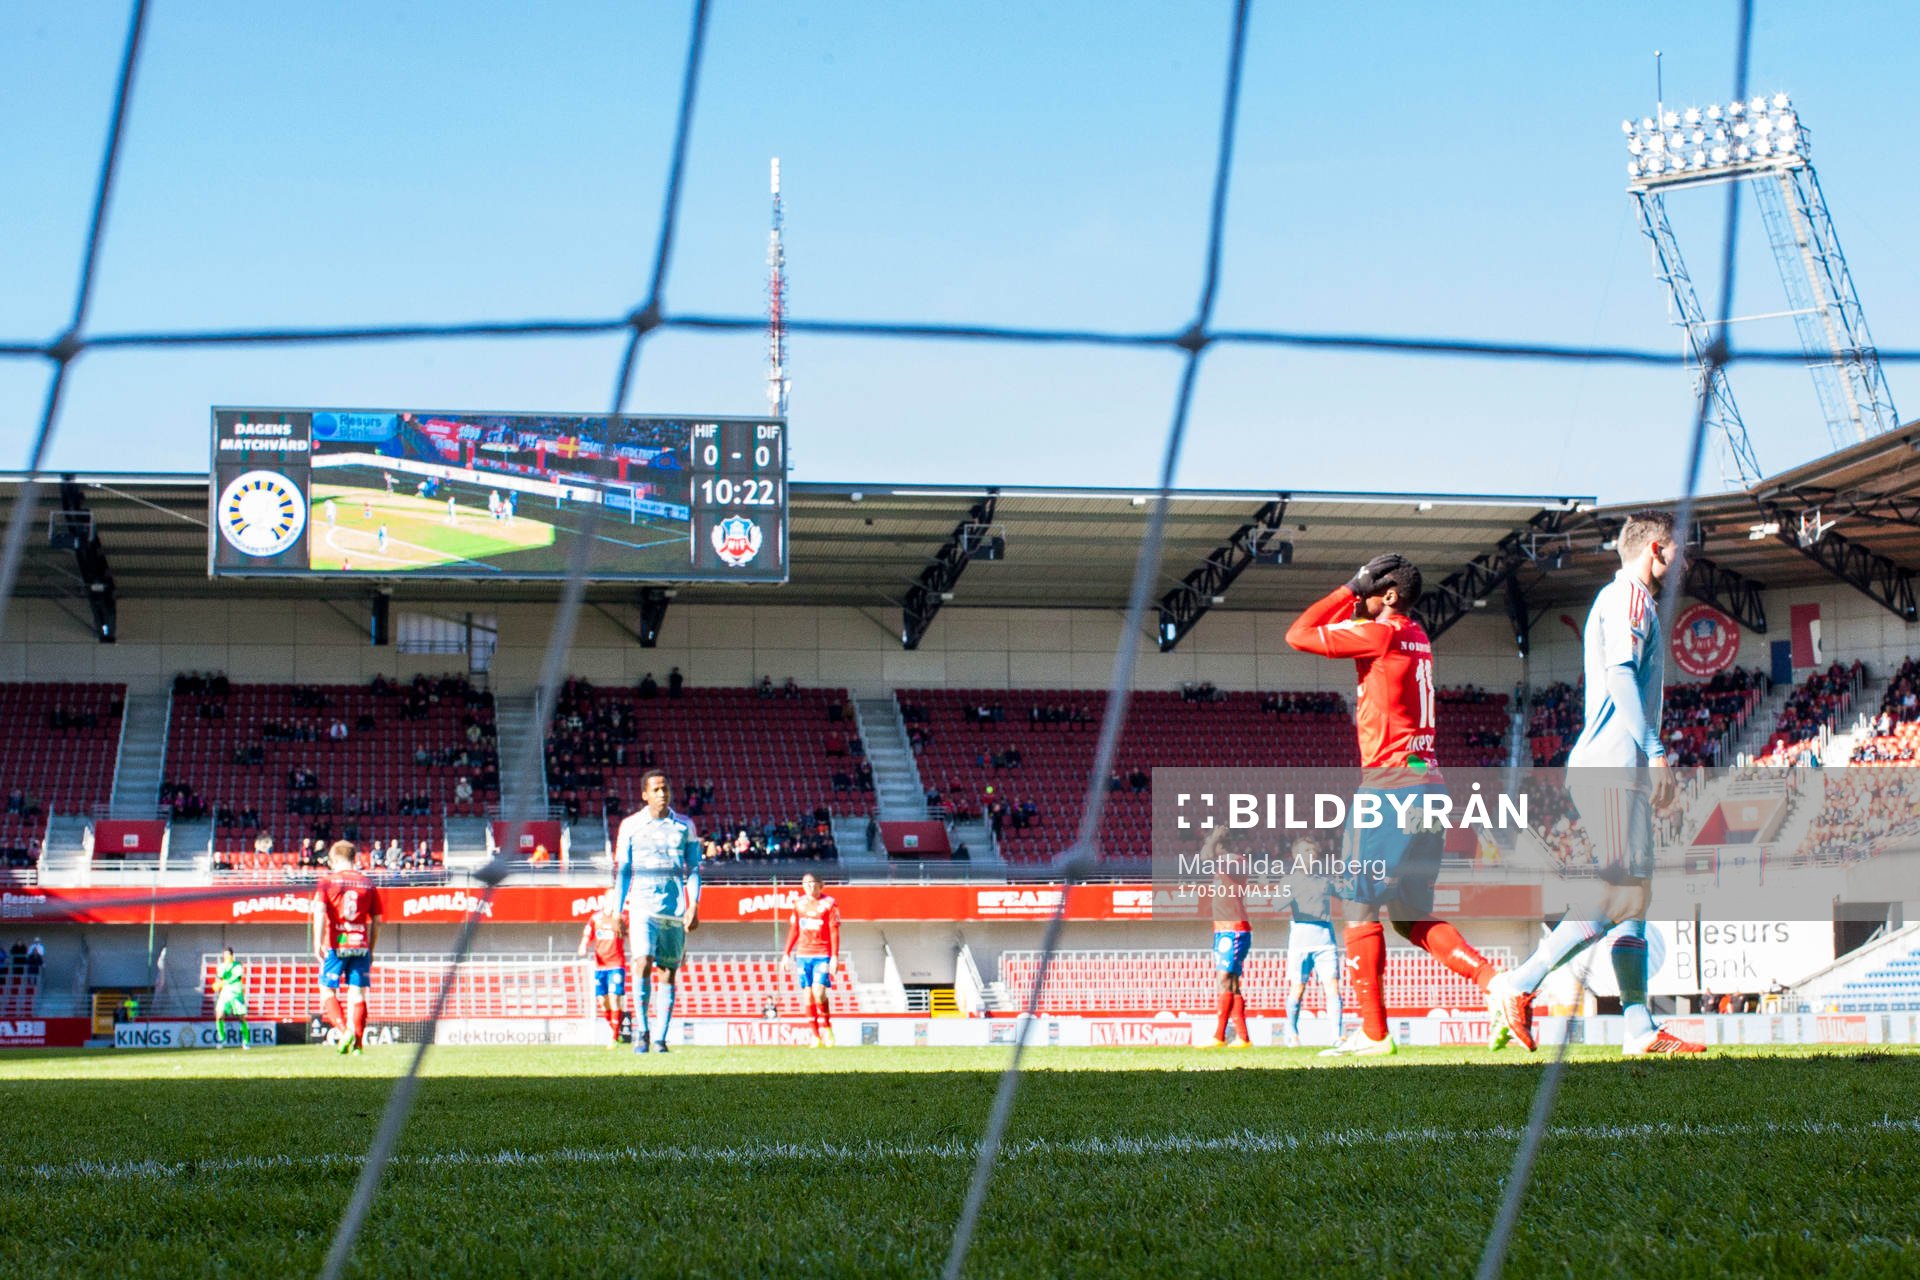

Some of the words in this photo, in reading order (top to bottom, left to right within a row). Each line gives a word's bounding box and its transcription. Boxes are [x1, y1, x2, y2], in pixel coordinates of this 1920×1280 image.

[234, 423, 292, 436] DAGENS
[694, 424, 718, 438] HIF
[757, 425, 780, 439] DIF
[220, 437, 309, 451] MATCHVÄRD
[704, 445, 719, 466] 0
[755, 446, 770, 467] 0
[702, 479, 775, 505] 10:22
[343, 890, 358, 921] 6
[1675, 919, 1789, 945] Resurs
[1677, 951, 1758, 979] Bank
[117, 1028, 172, 1047] KINGS
[448, 1029, 563, 1044] elektrokoppar
